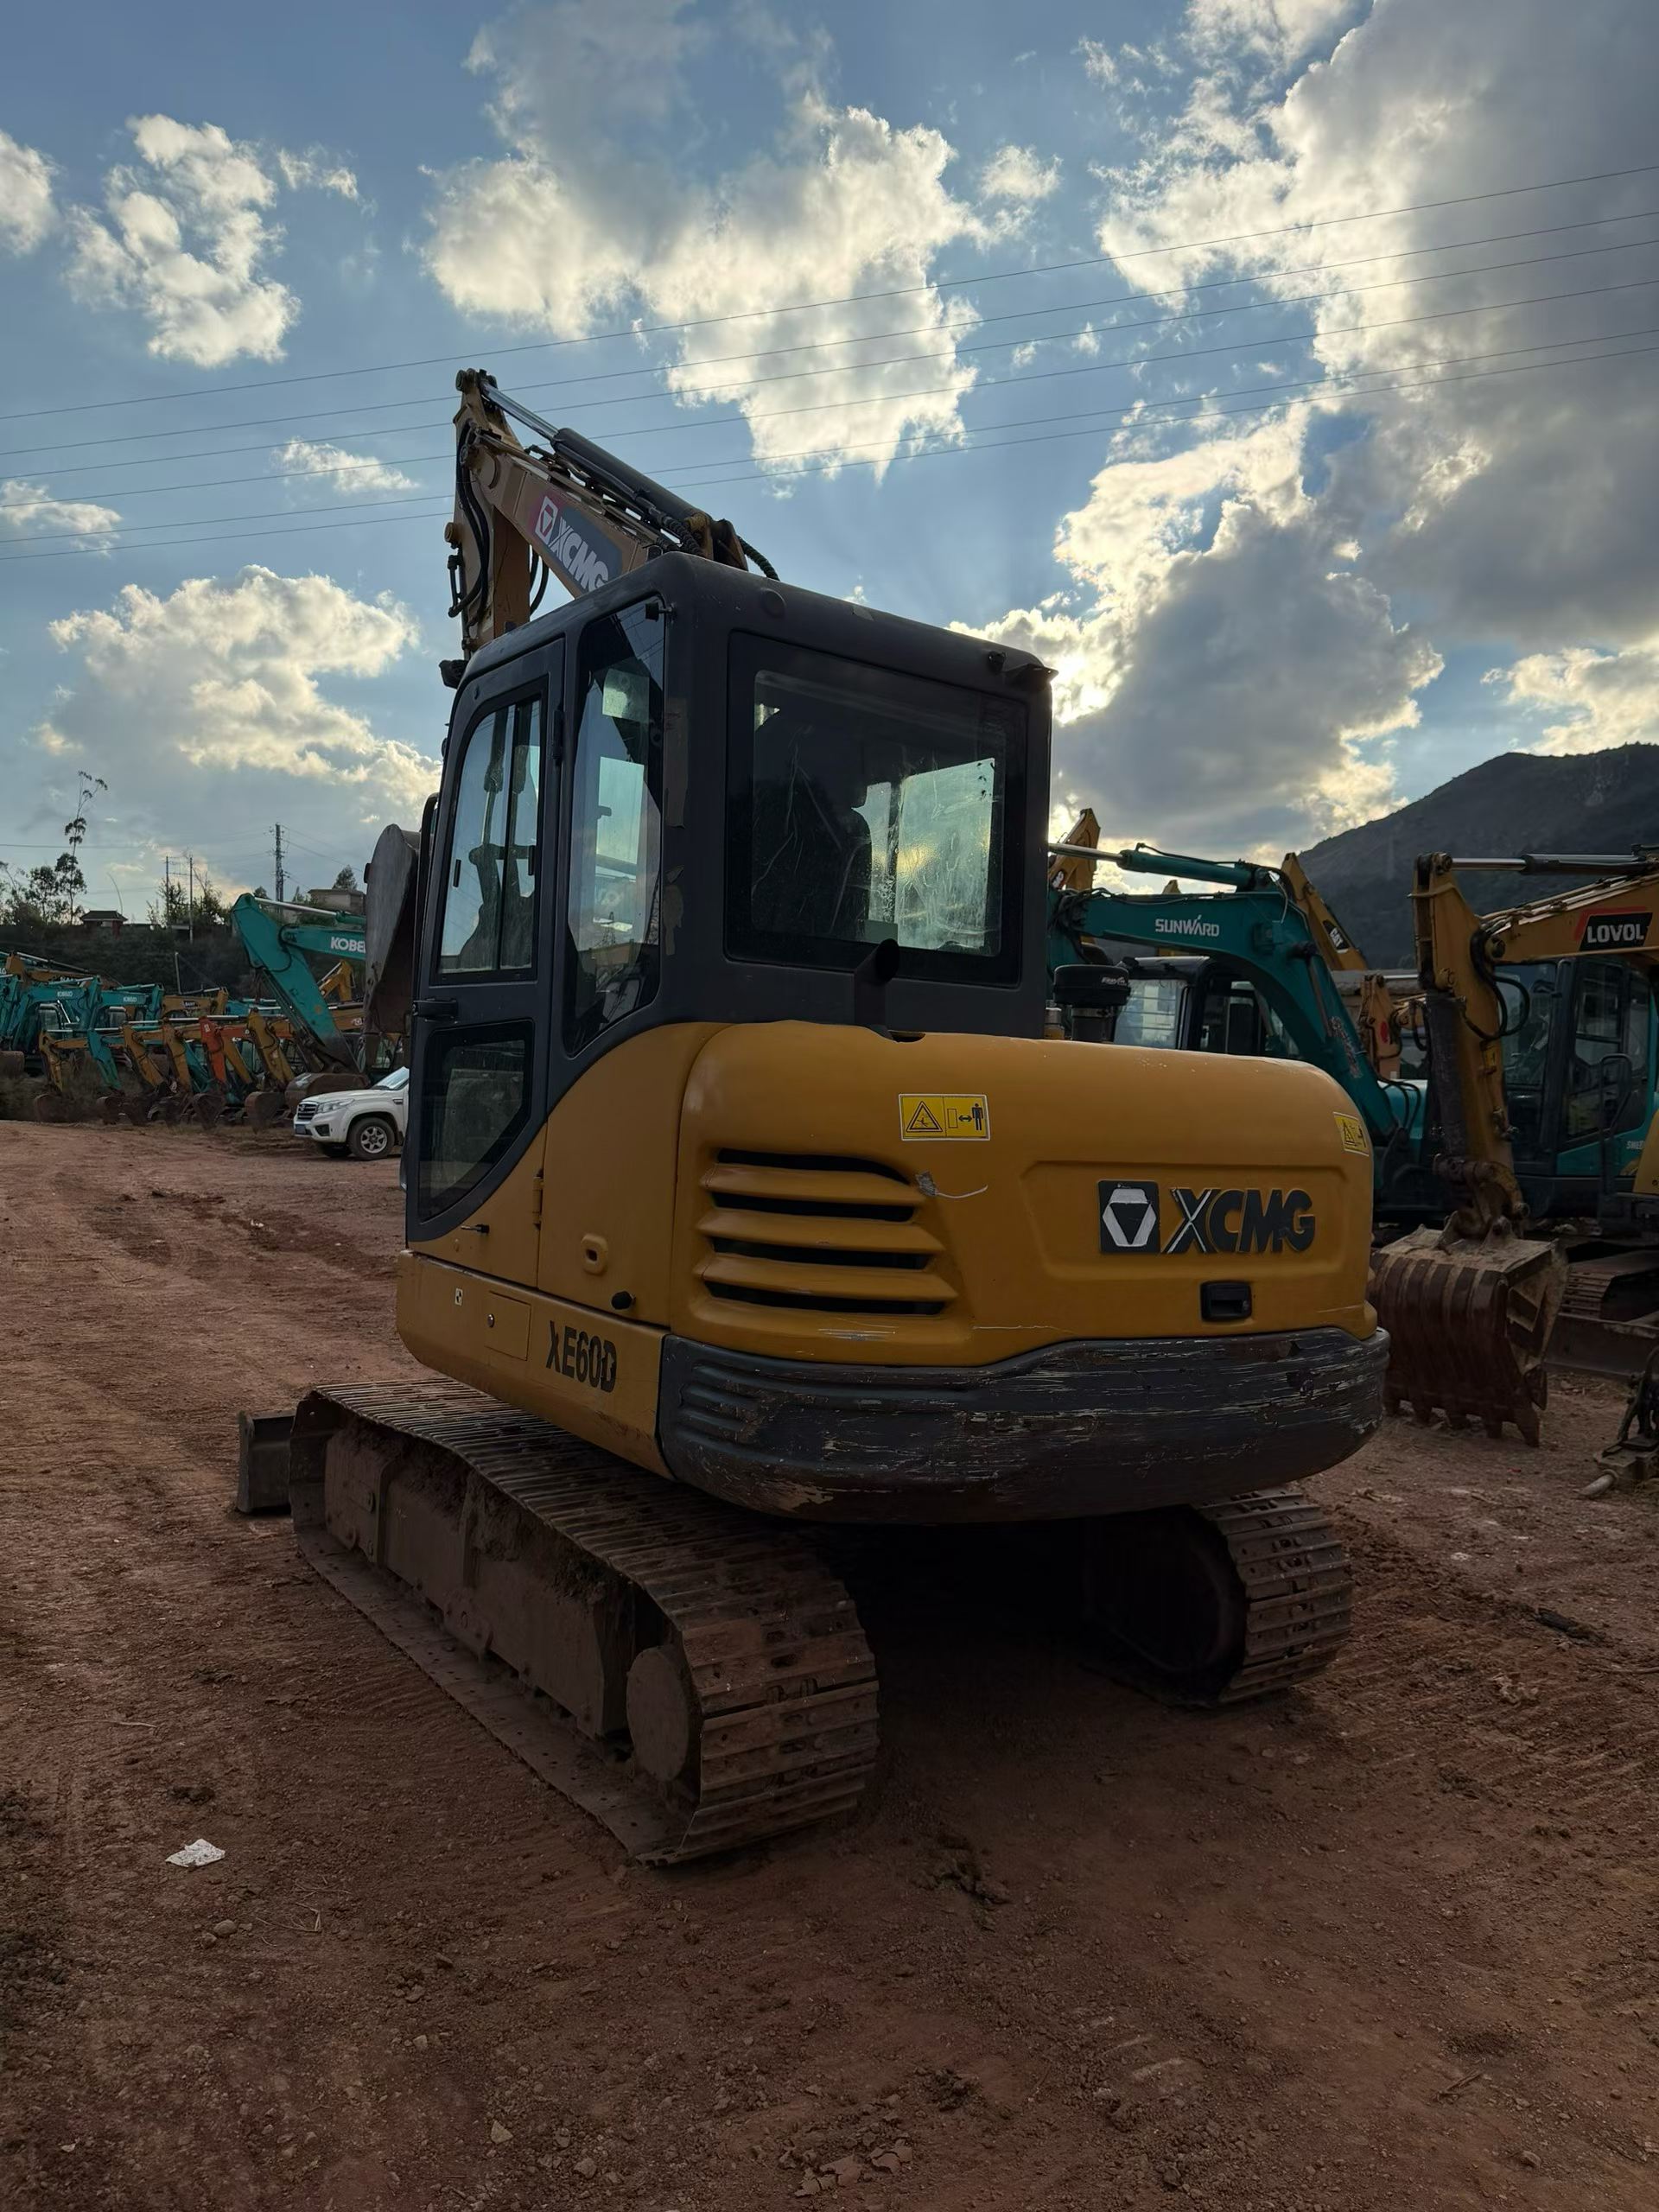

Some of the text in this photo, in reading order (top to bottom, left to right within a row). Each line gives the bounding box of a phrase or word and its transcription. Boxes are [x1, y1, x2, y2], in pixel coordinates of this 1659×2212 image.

[548, 516, 608, 592] XCMG
[1155, 914, 1219, 937] SUNWARD
[1587, 923, 1644, 944] LOVOL
[1161, 1187, 1315, 1254] XCMG
[546, 1320, 617, 1393] XE60D
